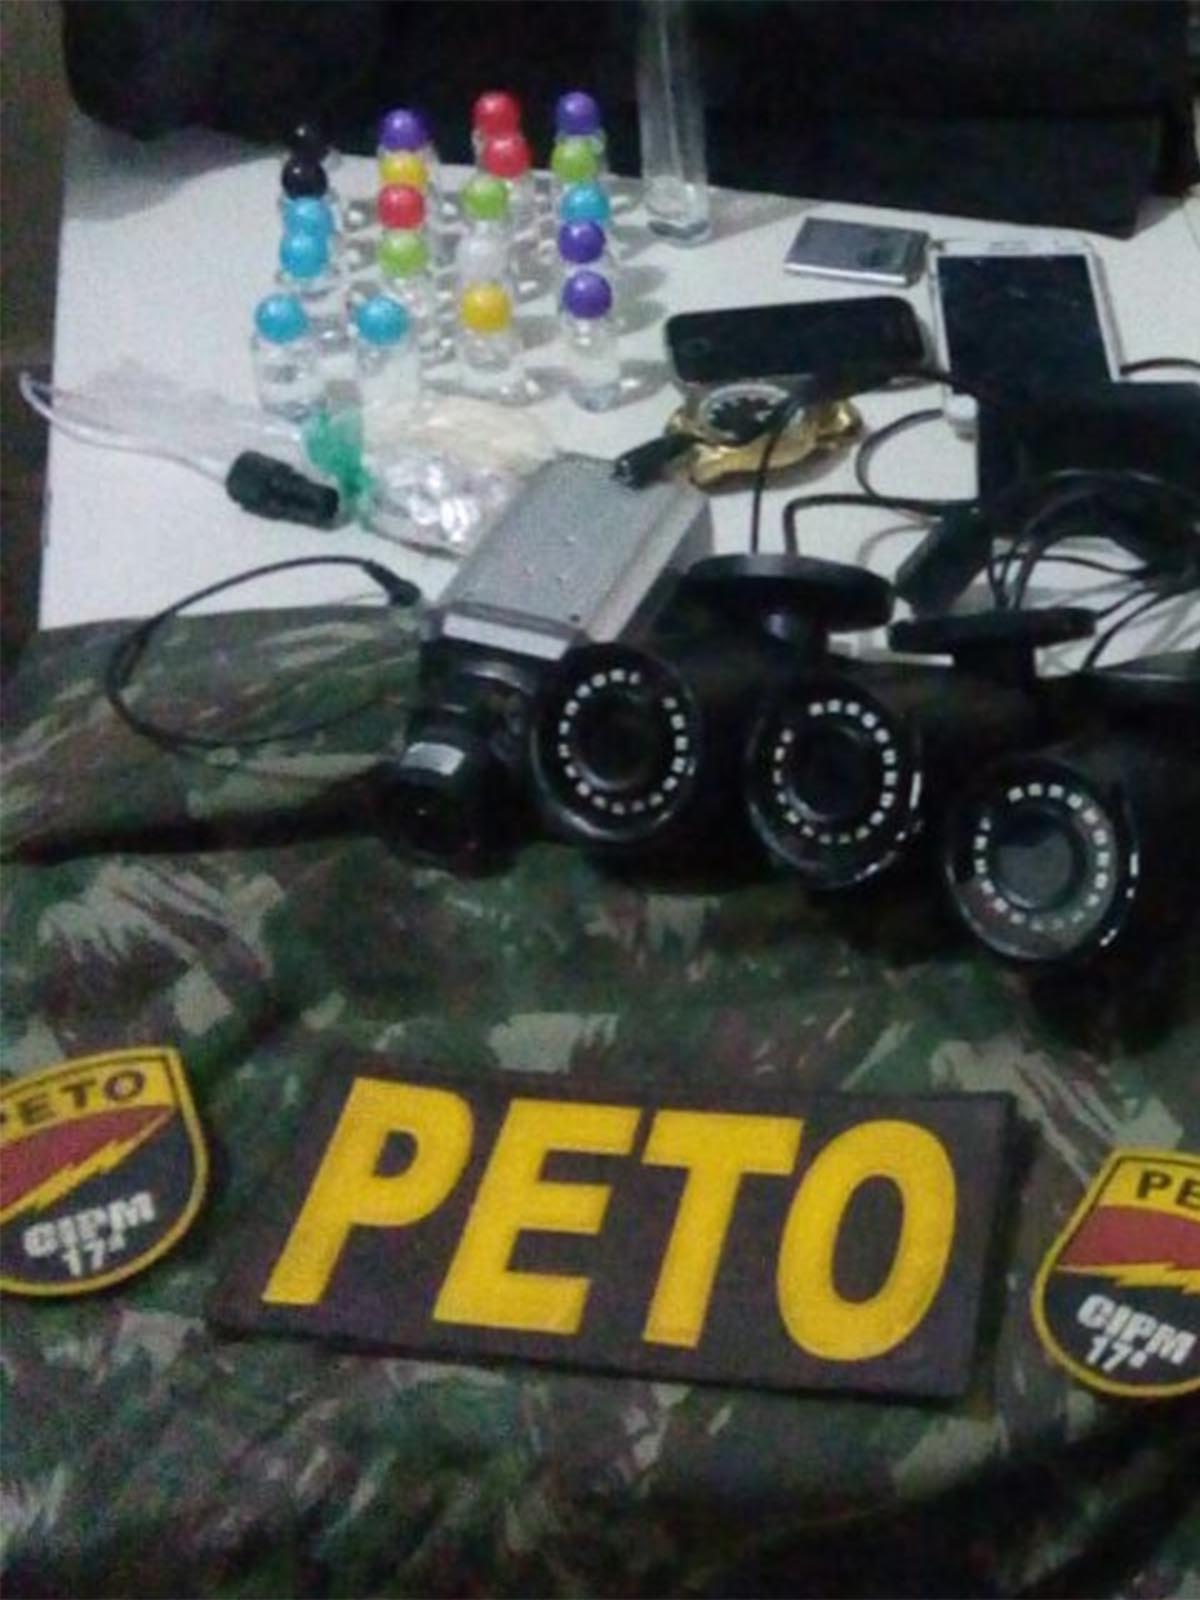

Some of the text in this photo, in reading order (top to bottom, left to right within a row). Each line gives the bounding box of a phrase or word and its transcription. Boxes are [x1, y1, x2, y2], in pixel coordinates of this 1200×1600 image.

[0, 1069, 145, 1126] ETO
[23, 1191, 156, 1258] CIPM
[262, 1076, 957, 1362] PETO
[1076, 1293, 1198, 1366] CIPM
